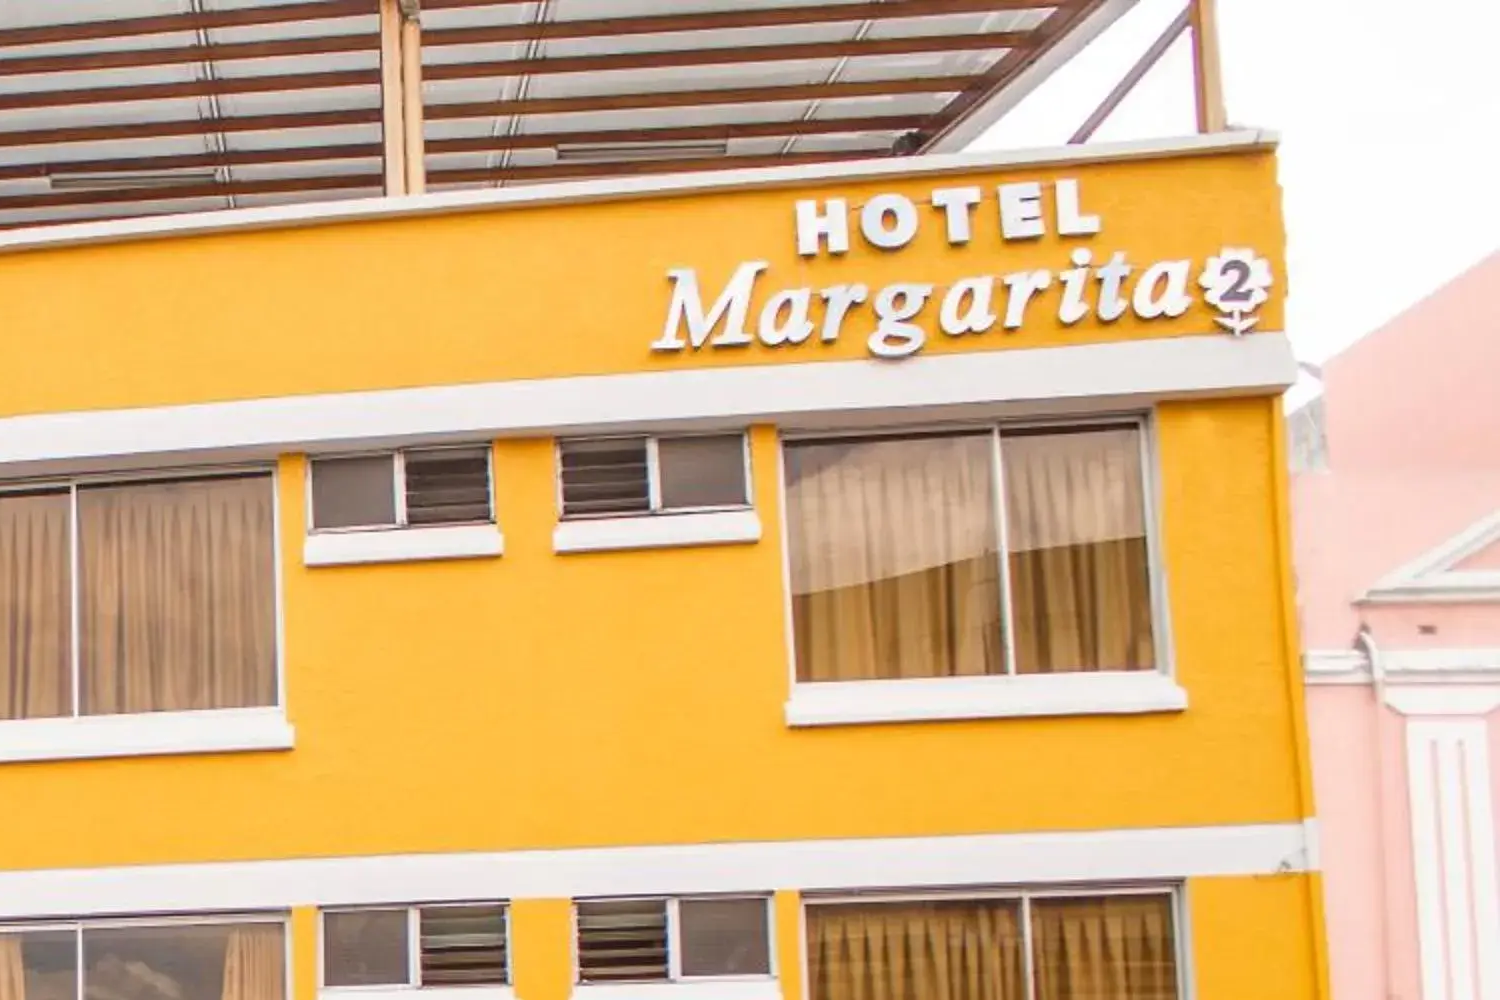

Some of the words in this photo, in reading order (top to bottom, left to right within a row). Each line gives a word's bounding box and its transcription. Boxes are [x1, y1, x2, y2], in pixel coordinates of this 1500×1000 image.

[795, 178, 1102, 256] HOTEL
[651, 247, 1193, 358] Margarita
[1219, 259, 1254, 302] 2
